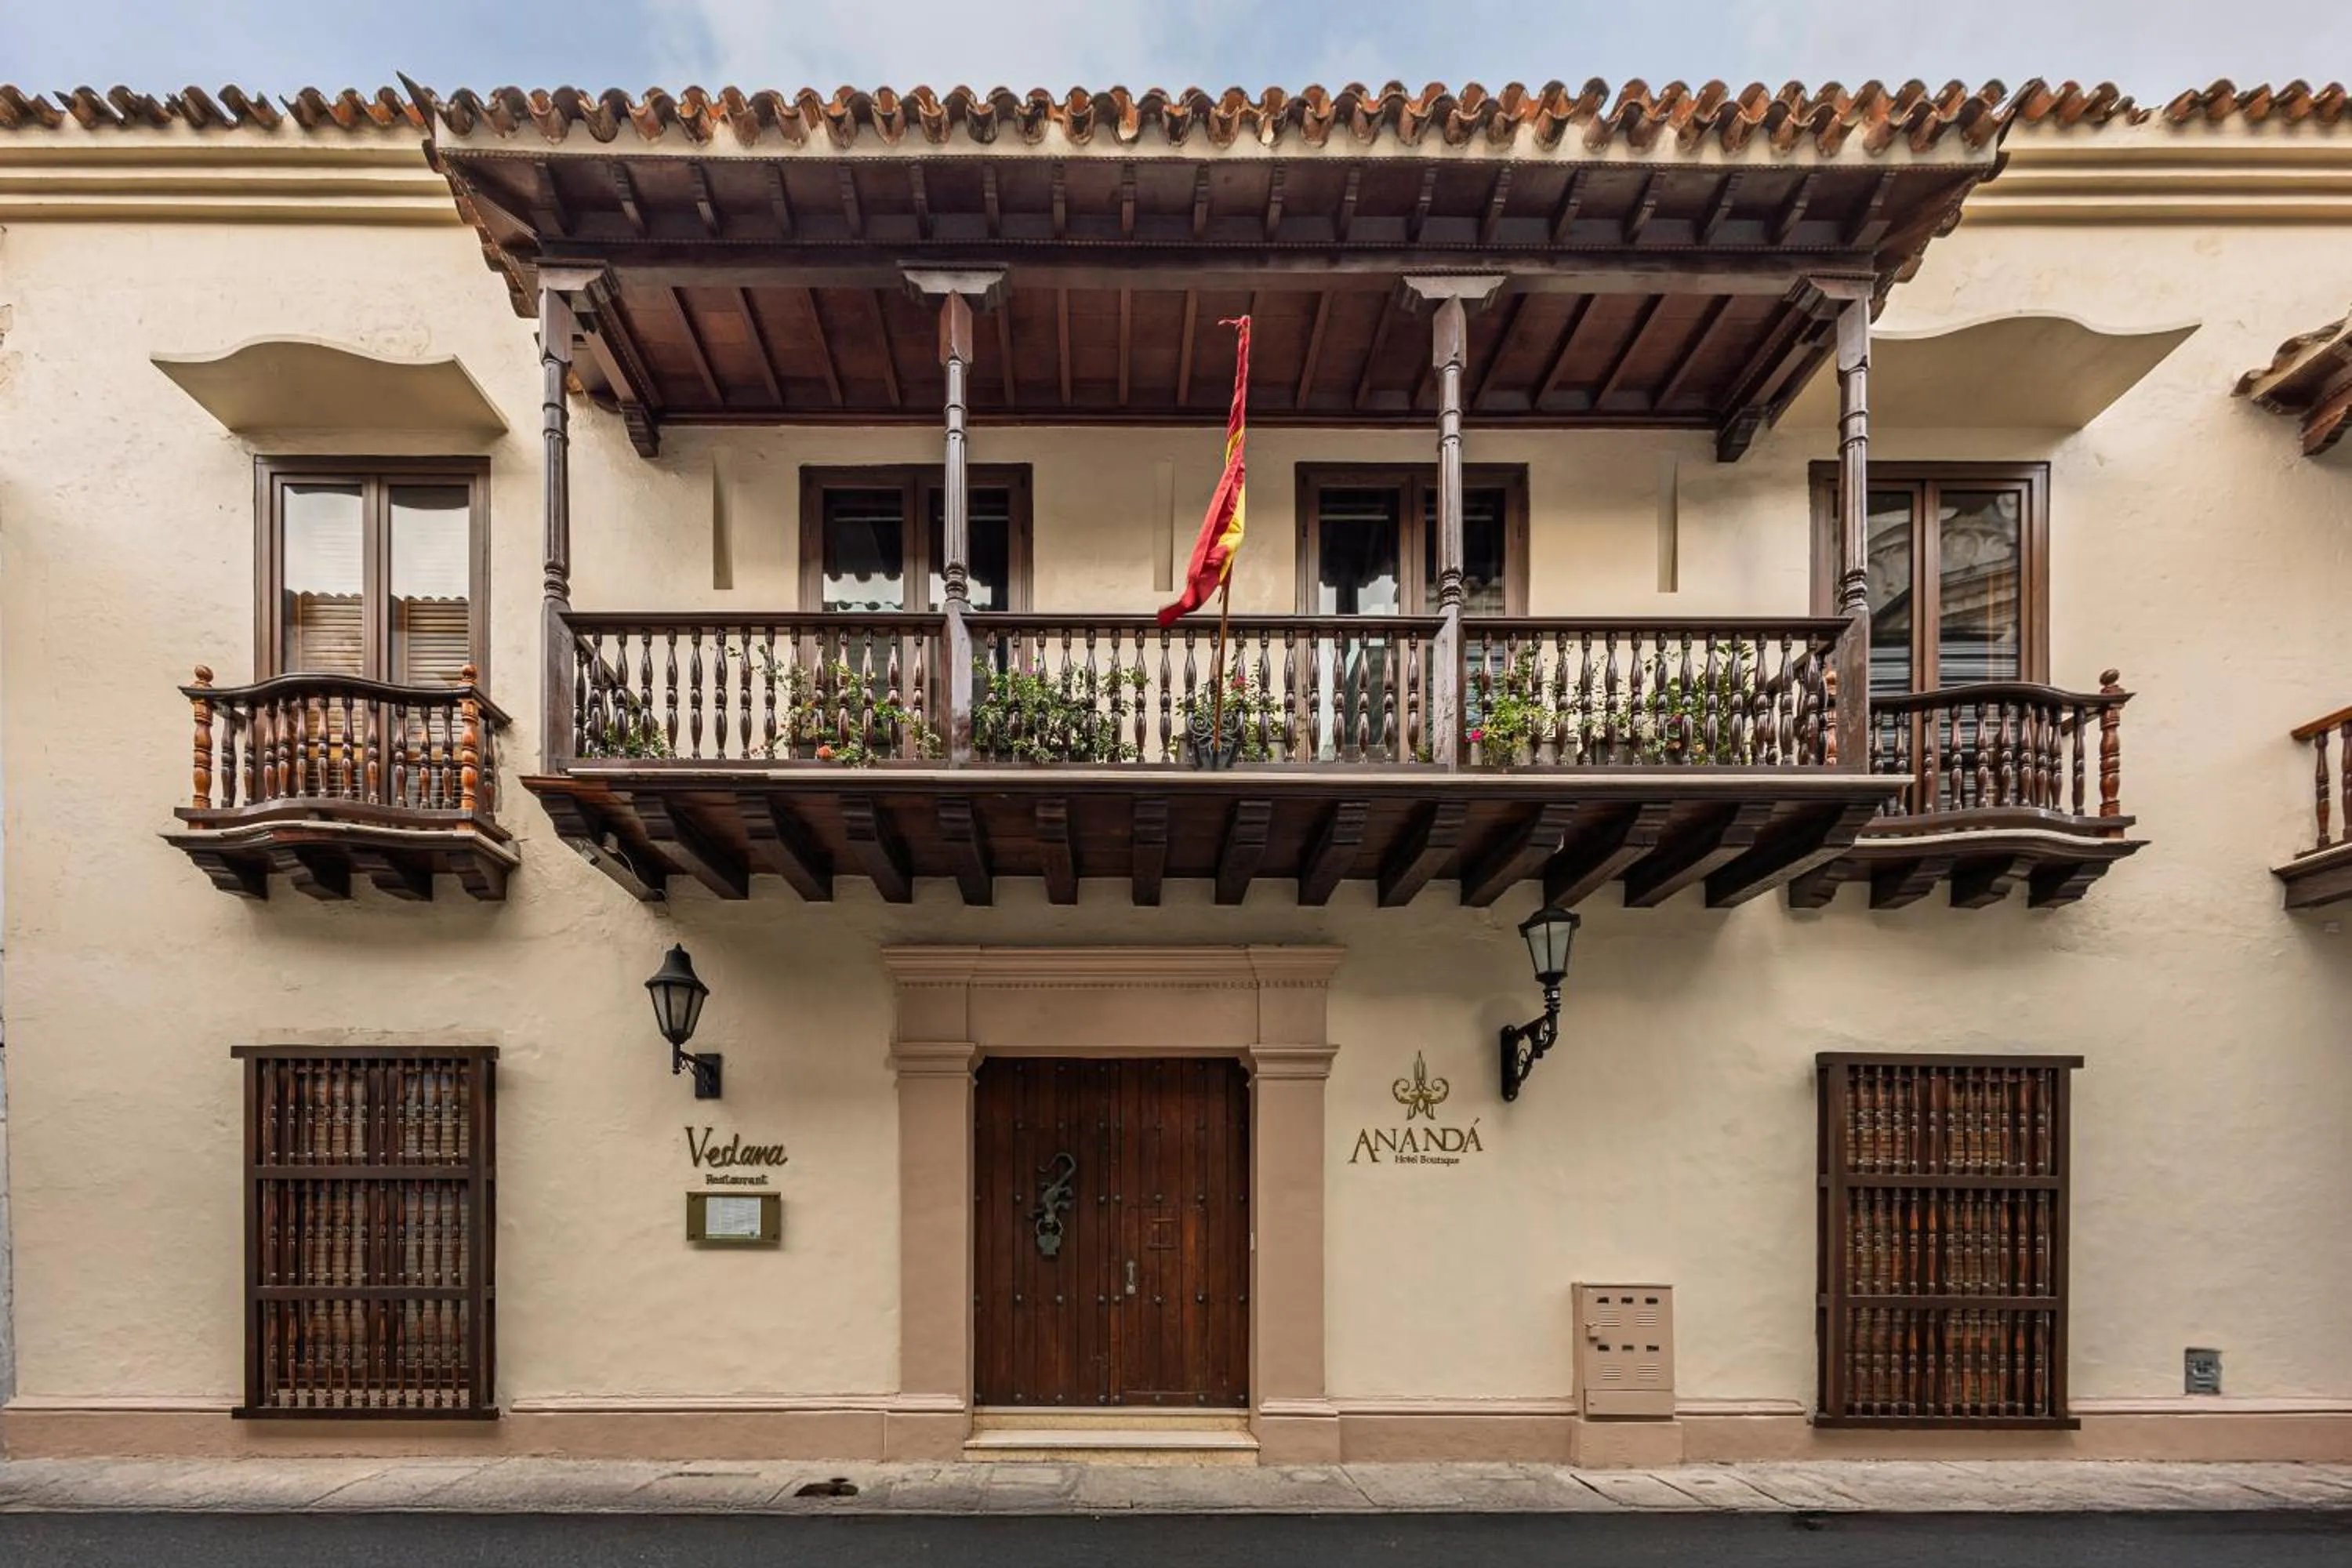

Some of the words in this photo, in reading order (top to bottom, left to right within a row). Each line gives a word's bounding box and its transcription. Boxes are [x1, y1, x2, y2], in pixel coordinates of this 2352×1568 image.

[685, 1127, 788, 1167] Vedana
[1349, 1117, 1483, 1164] ANANDÁ
[1395, 1155, 1418, 1164] Hotel
[1420, 1155, 1460, 1167] Boutique
[706, 1174, 768, 1185] Restaurant
